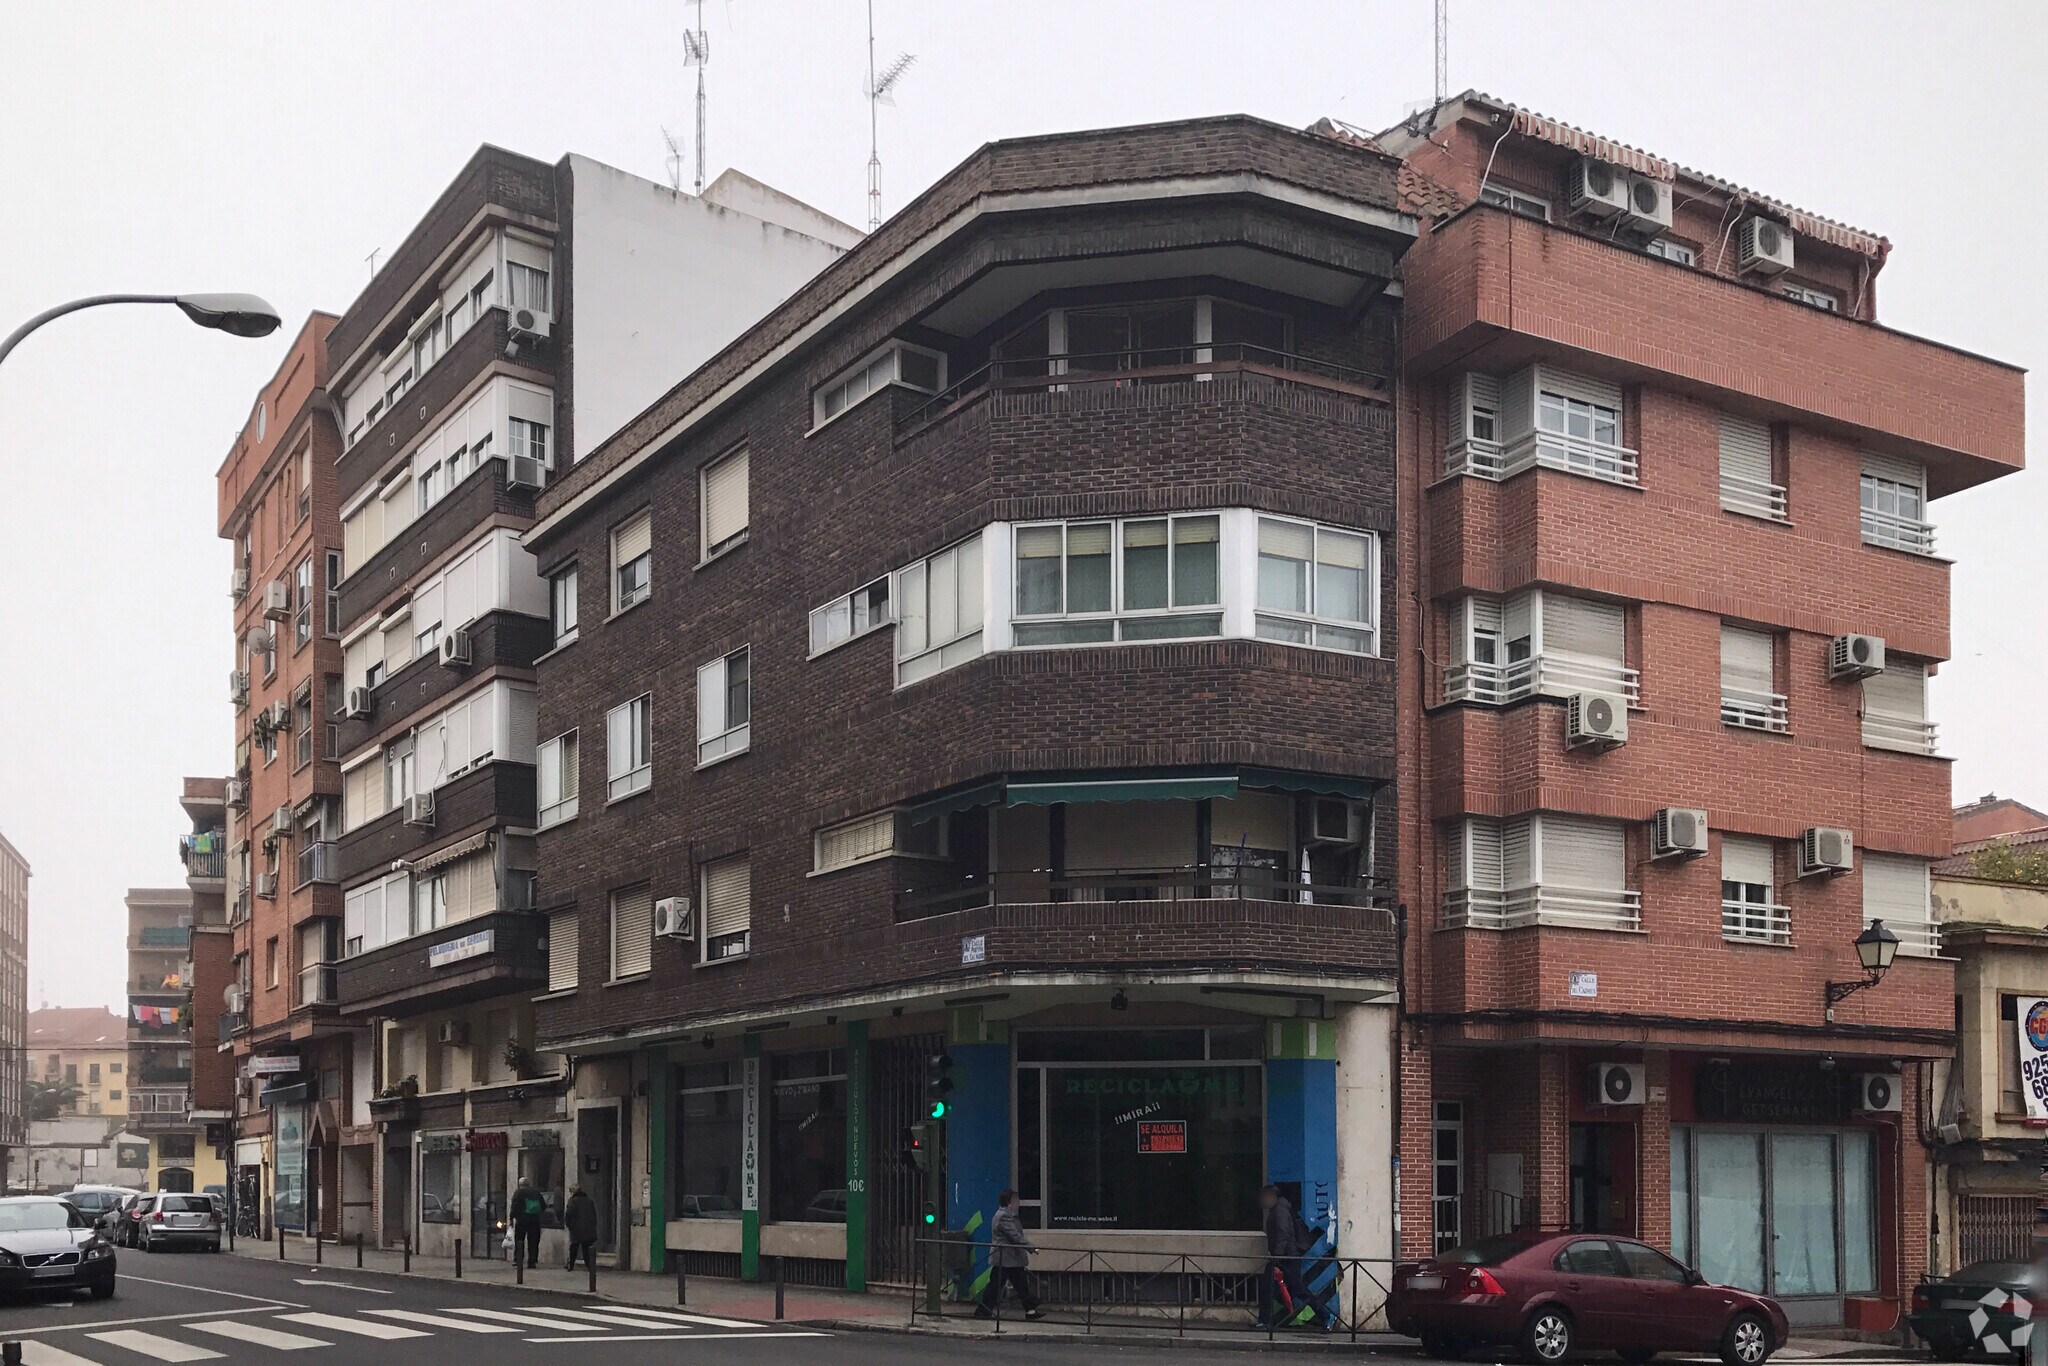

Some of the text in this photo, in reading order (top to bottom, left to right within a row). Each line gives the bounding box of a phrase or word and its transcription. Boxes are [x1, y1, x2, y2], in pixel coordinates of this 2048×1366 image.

[1140, 1123, 1183, 1134] SE ALQUILA
[848, 1179, 864, 1192] 10€
